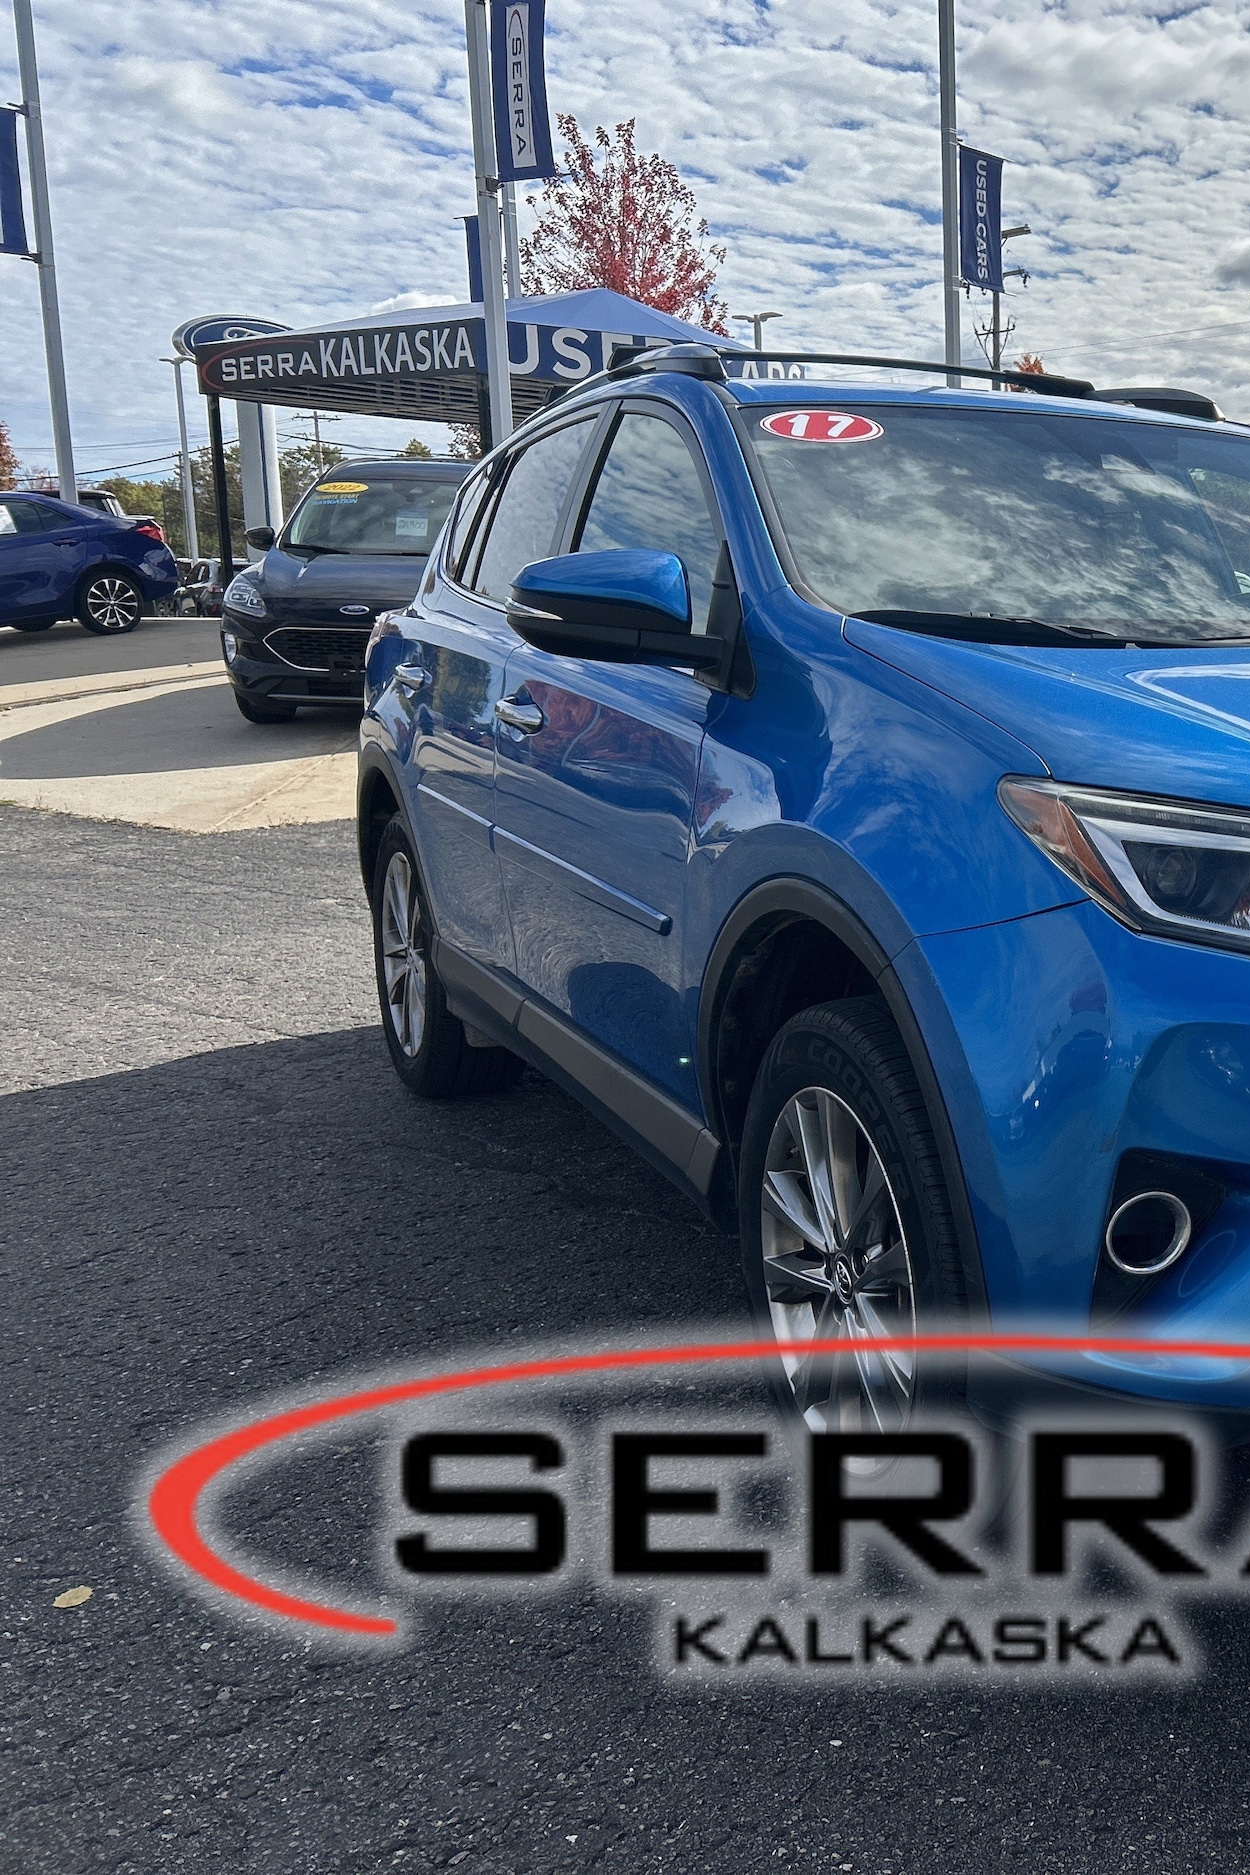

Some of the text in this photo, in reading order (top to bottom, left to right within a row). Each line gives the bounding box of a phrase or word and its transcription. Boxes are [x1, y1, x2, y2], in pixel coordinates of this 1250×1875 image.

[512, 37, 527, 157] SERRA
[975, 159, 989, 280] USED CARS
[221, 326, 476, 382] SERRA KALKASKA
